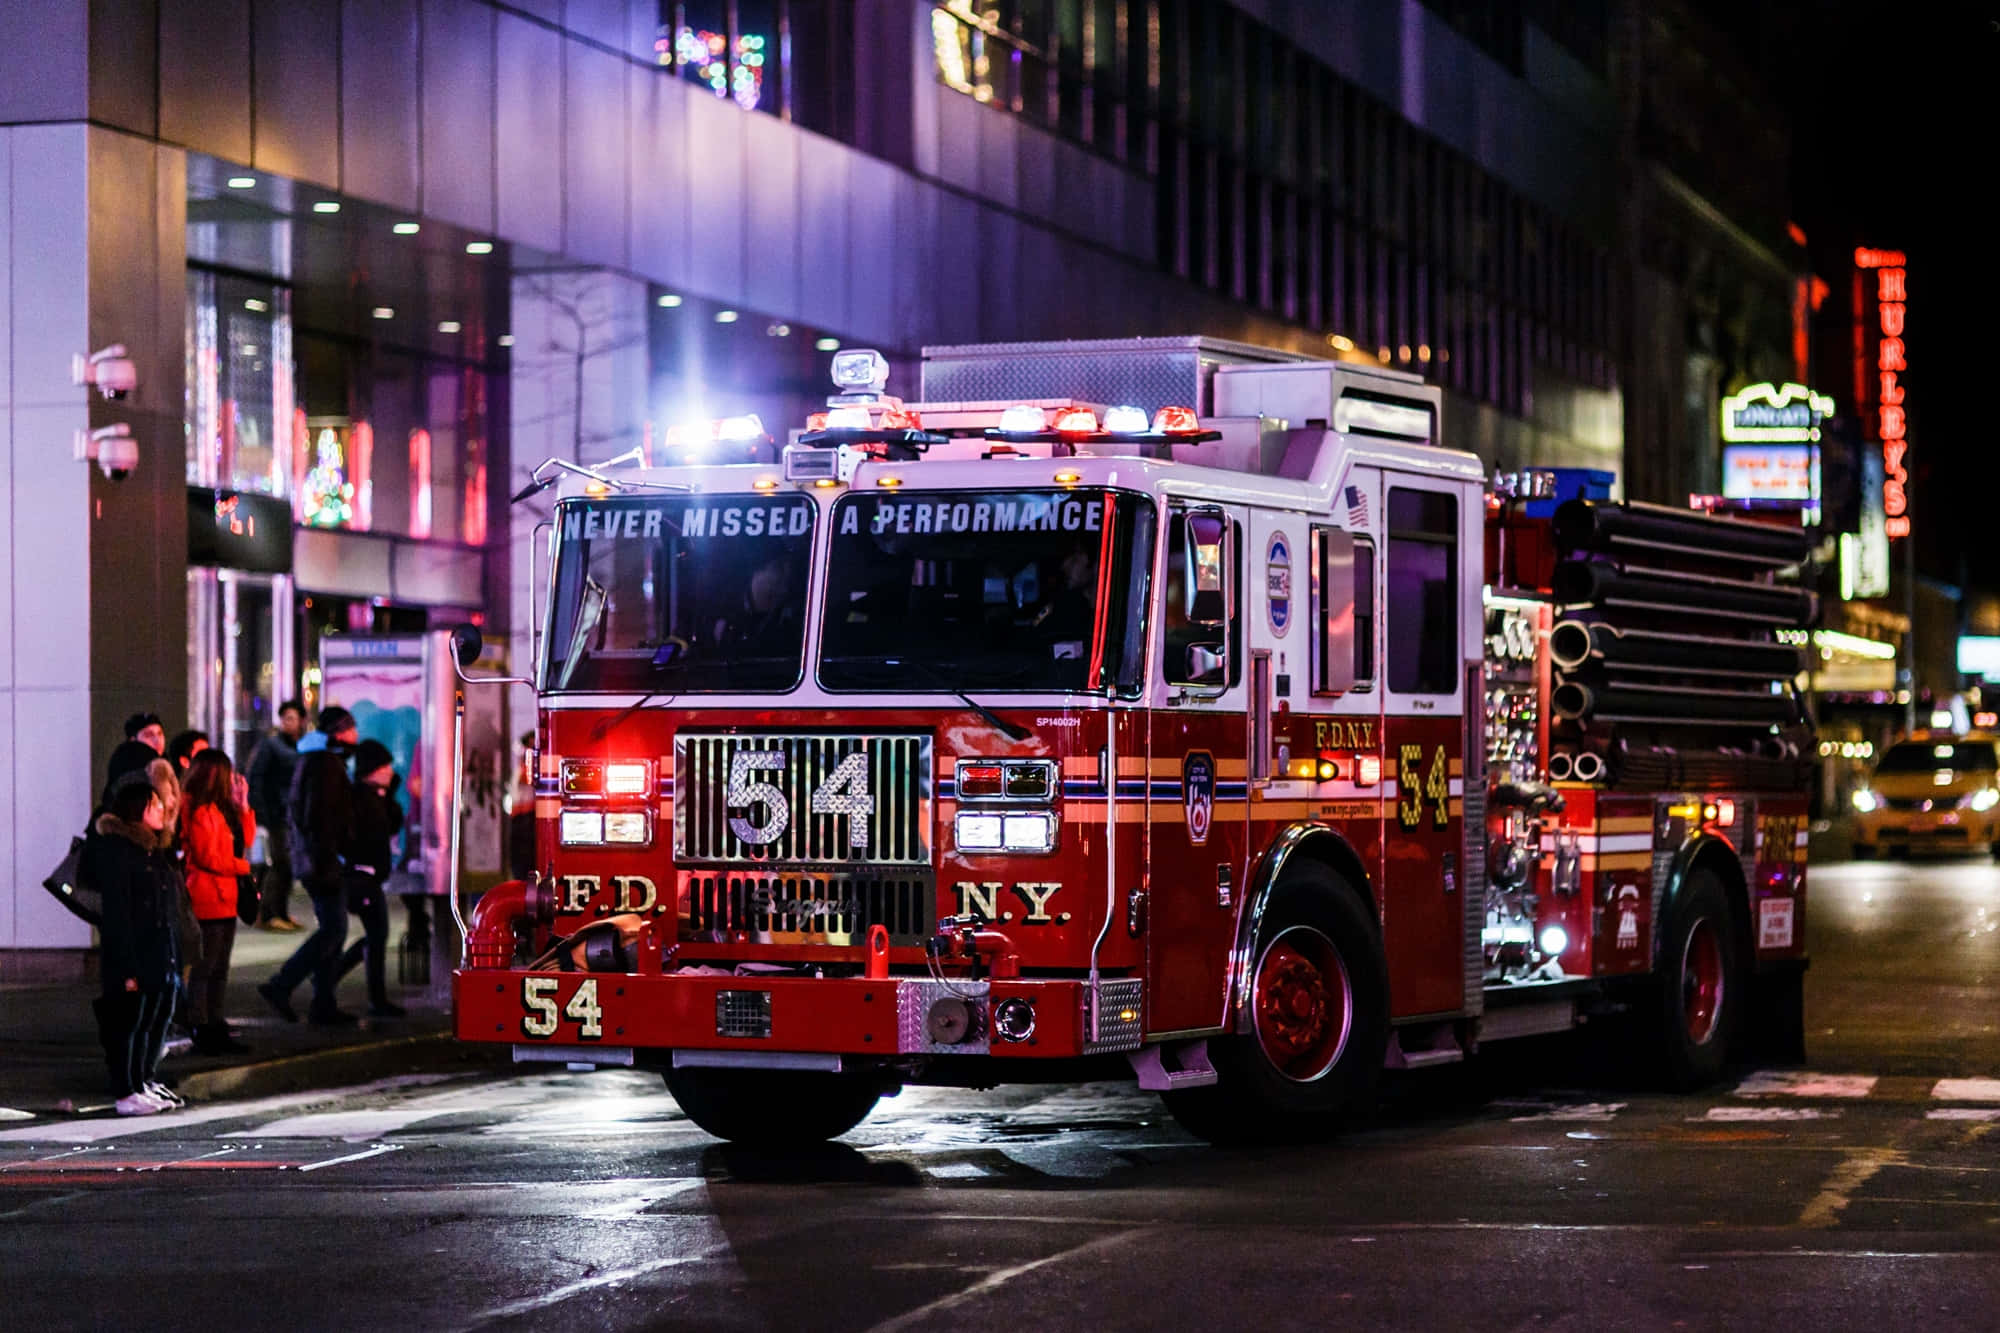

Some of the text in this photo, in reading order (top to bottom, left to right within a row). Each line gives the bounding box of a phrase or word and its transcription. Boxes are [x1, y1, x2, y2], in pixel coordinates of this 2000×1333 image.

[564, 501, 1102, 541] NEVER MISSED A PERFORMANCE
[727, 750, 875, 848] 54
[1401, 744, 1449, 826] 54
[562, 874, 1072, 921] F.D. N.Y.
[523, 976, 603, 1037] 54
